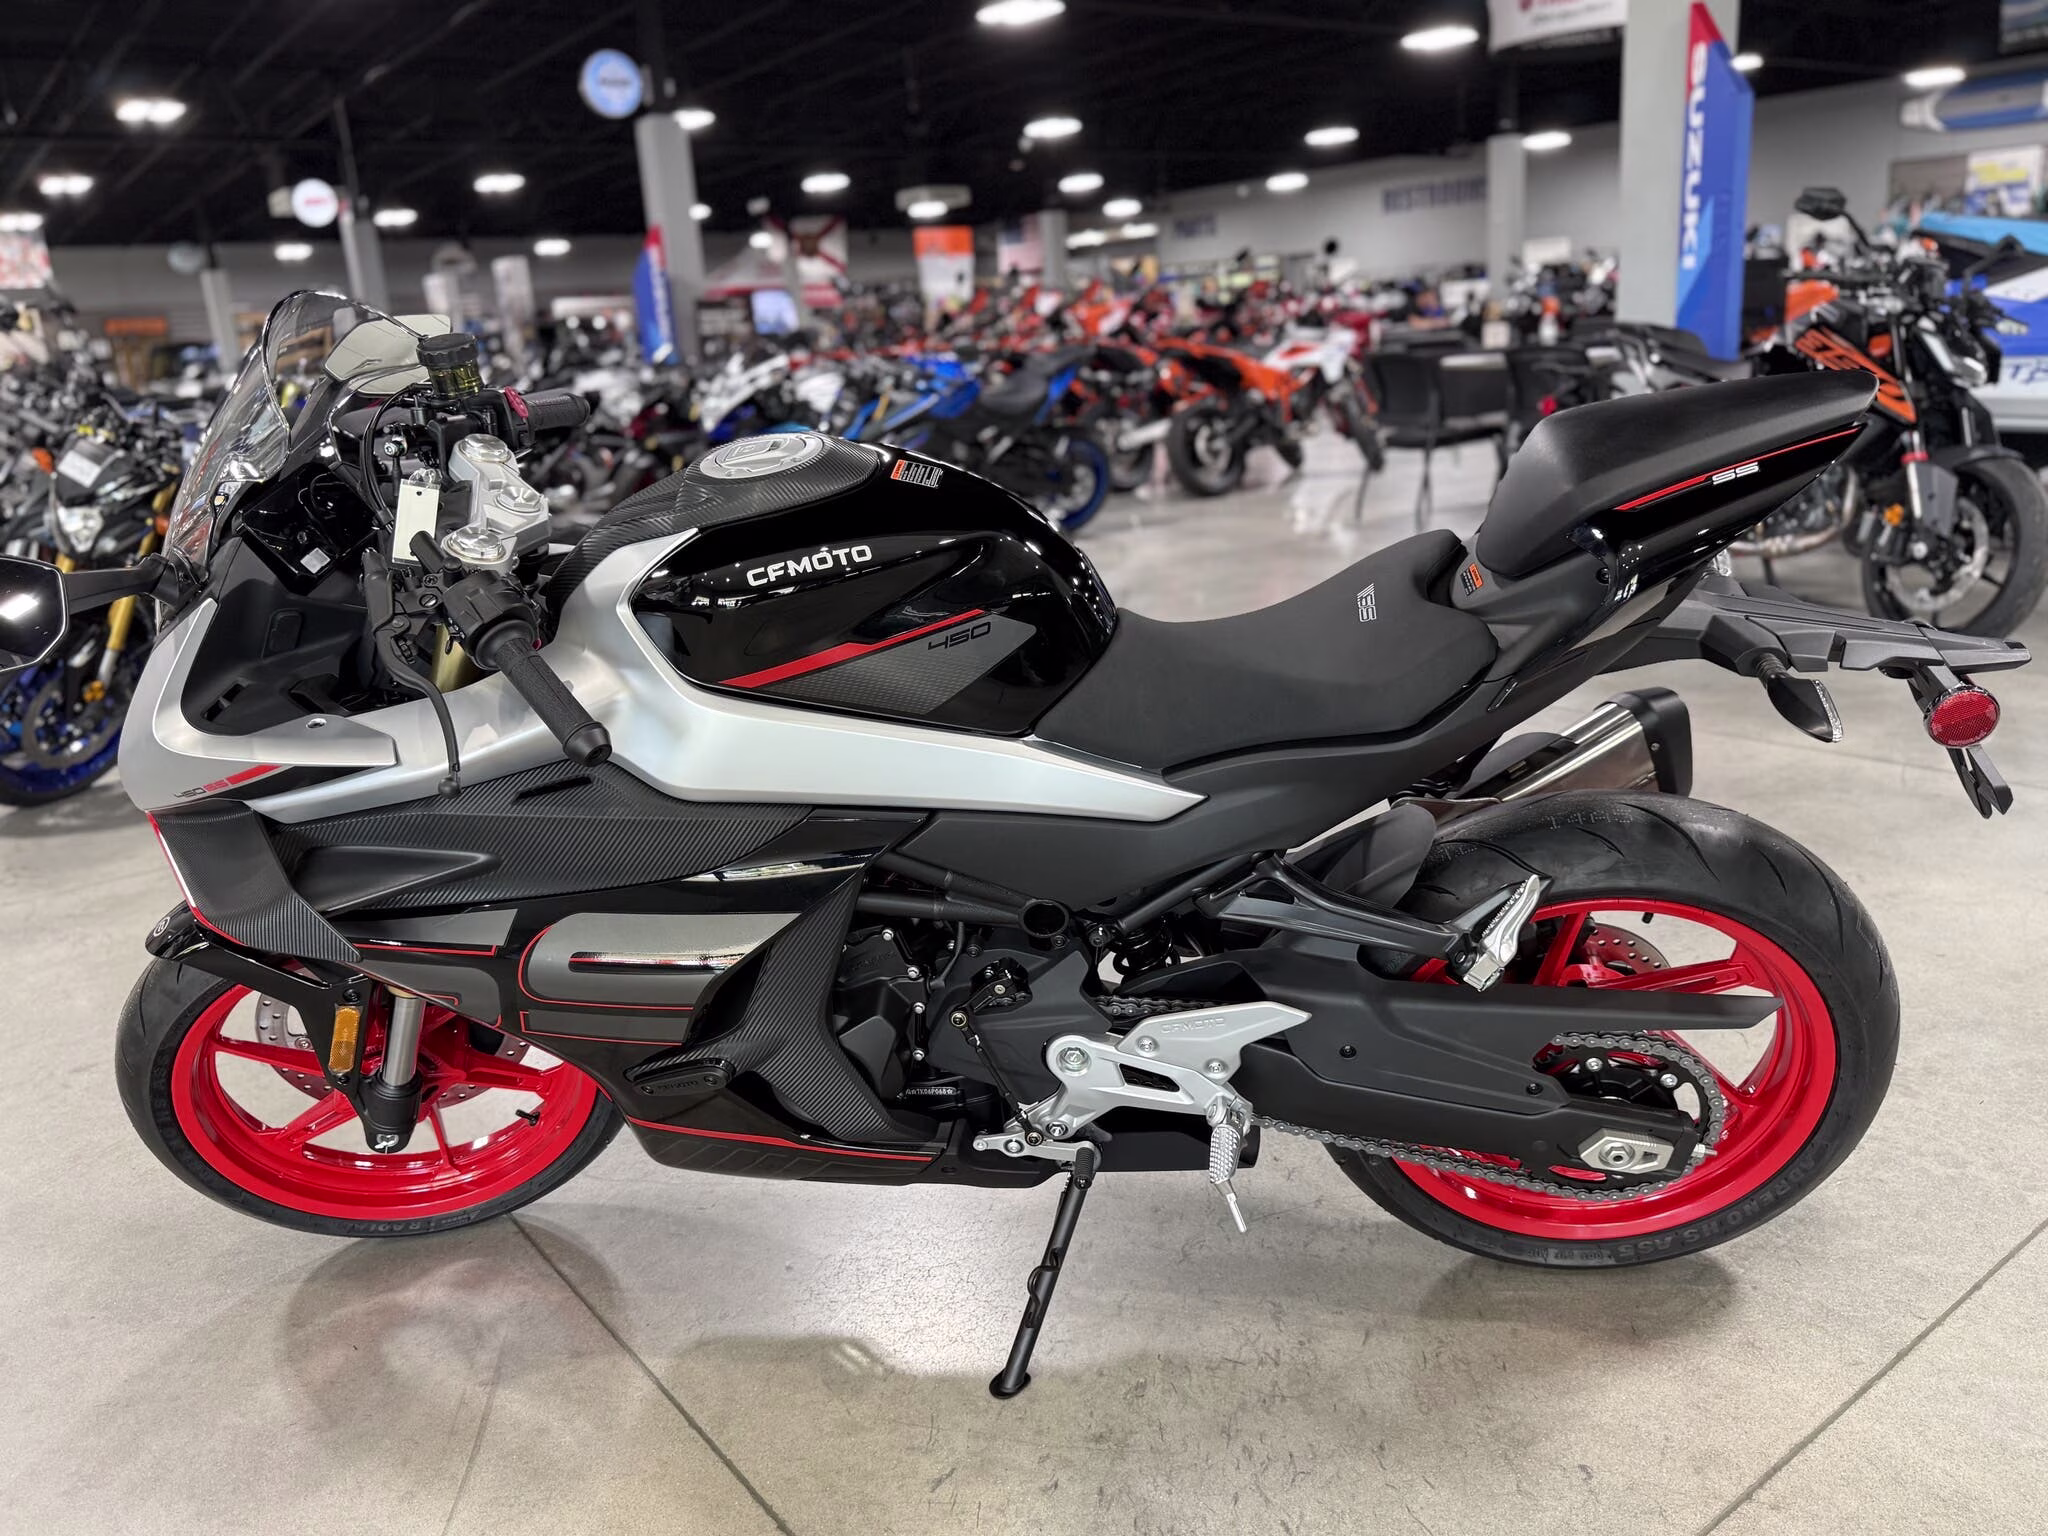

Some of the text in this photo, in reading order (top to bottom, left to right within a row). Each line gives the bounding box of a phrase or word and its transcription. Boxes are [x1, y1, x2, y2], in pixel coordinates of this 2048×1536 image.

[1681, 41, 1708, 270] SUZUKI
[1712, 461, 1760, 485] SS
[746, 544, 873, 587] CFMOTO
[927, 621, 992, 650] 450
[1160, 1018, 1225, 1034] CFMOTO
